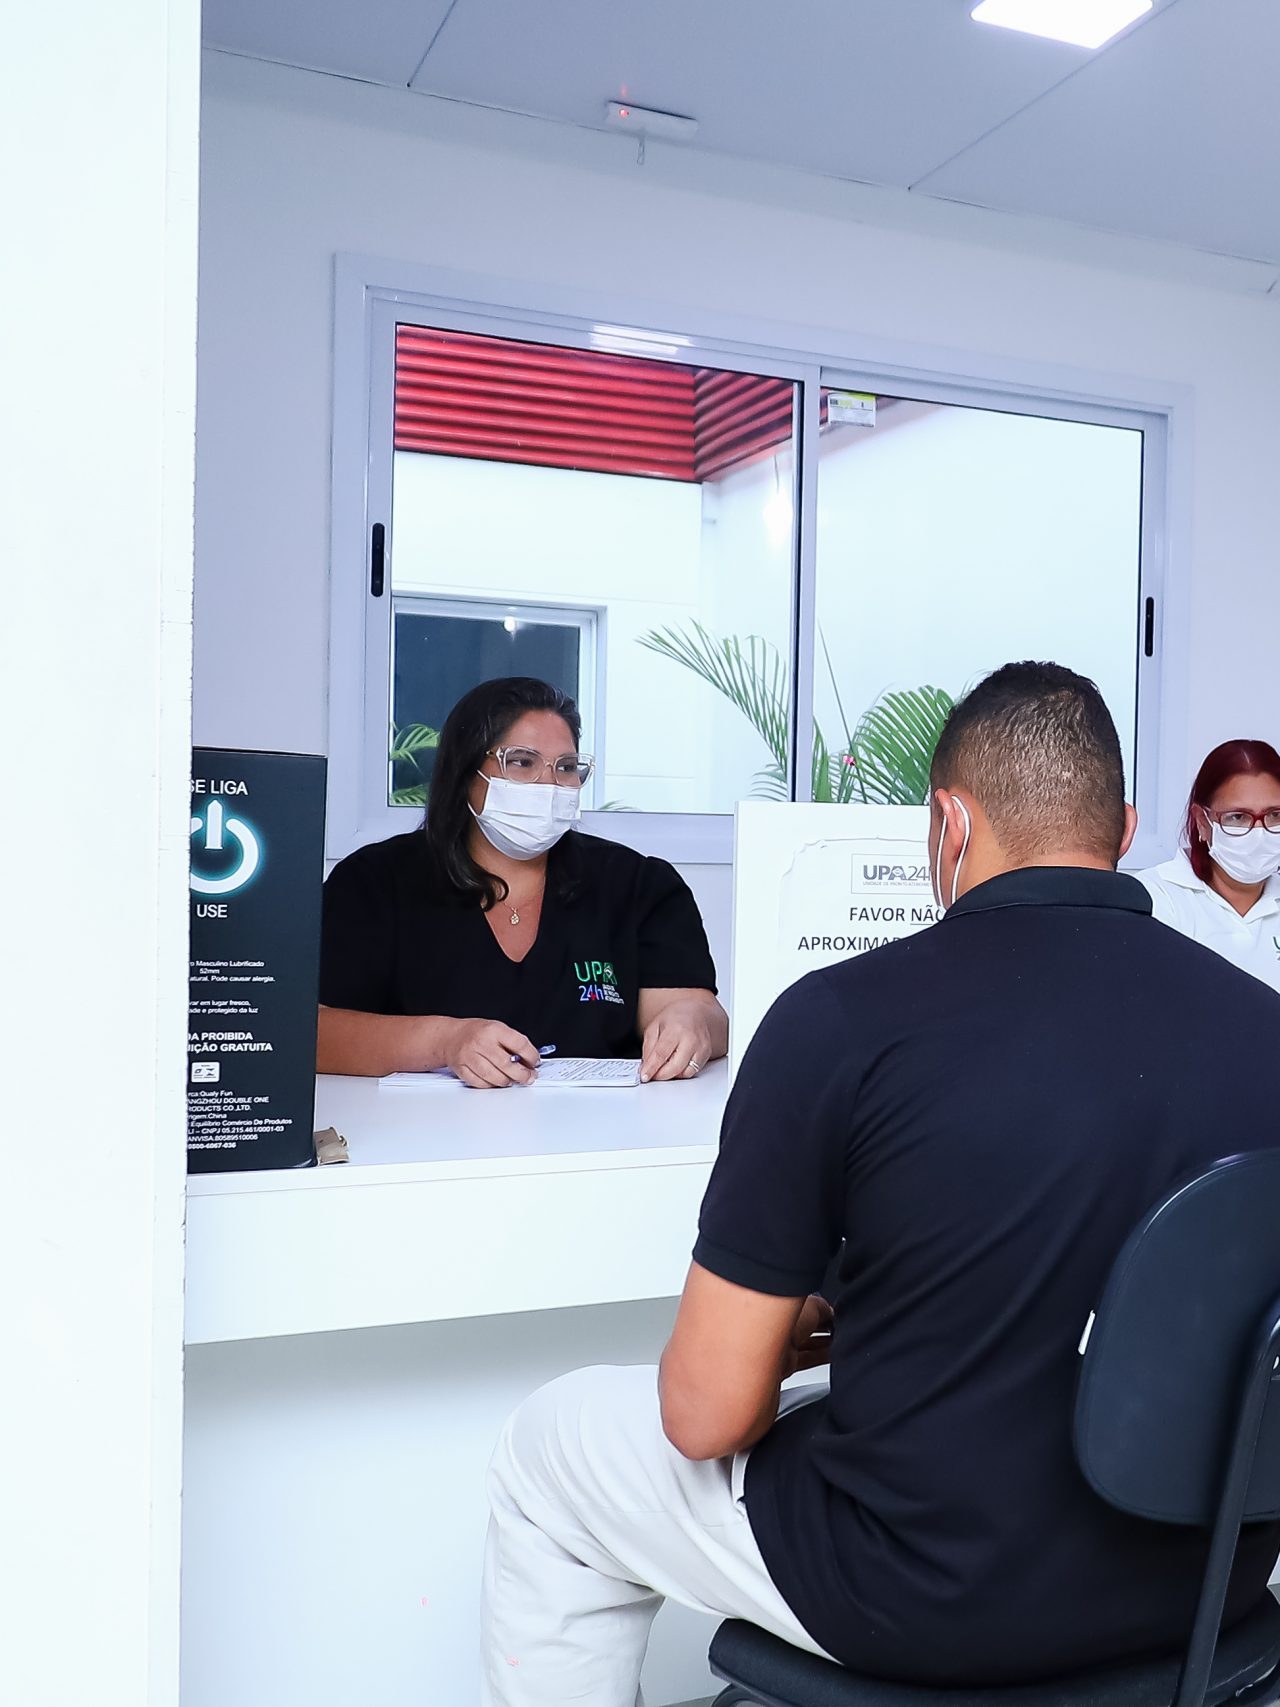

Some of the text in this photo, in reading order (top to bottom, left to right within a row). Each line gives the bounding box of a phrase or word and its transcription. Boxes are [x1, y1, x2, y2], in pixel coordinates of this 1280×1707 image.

[211, 780, 248, 795] LIGA
[197, 905, 227, 918] USE
[850, 907, 905, 921] FAVOR
[798, 937, 900, 950] APROXIMA
[574, 961, 617, 985] UPA
[579, 984, 604, 1001] 24h
[201, 1032, 253, 1040] PROIBIDA
[220, 1043, 273, 1051] GRATUITA
